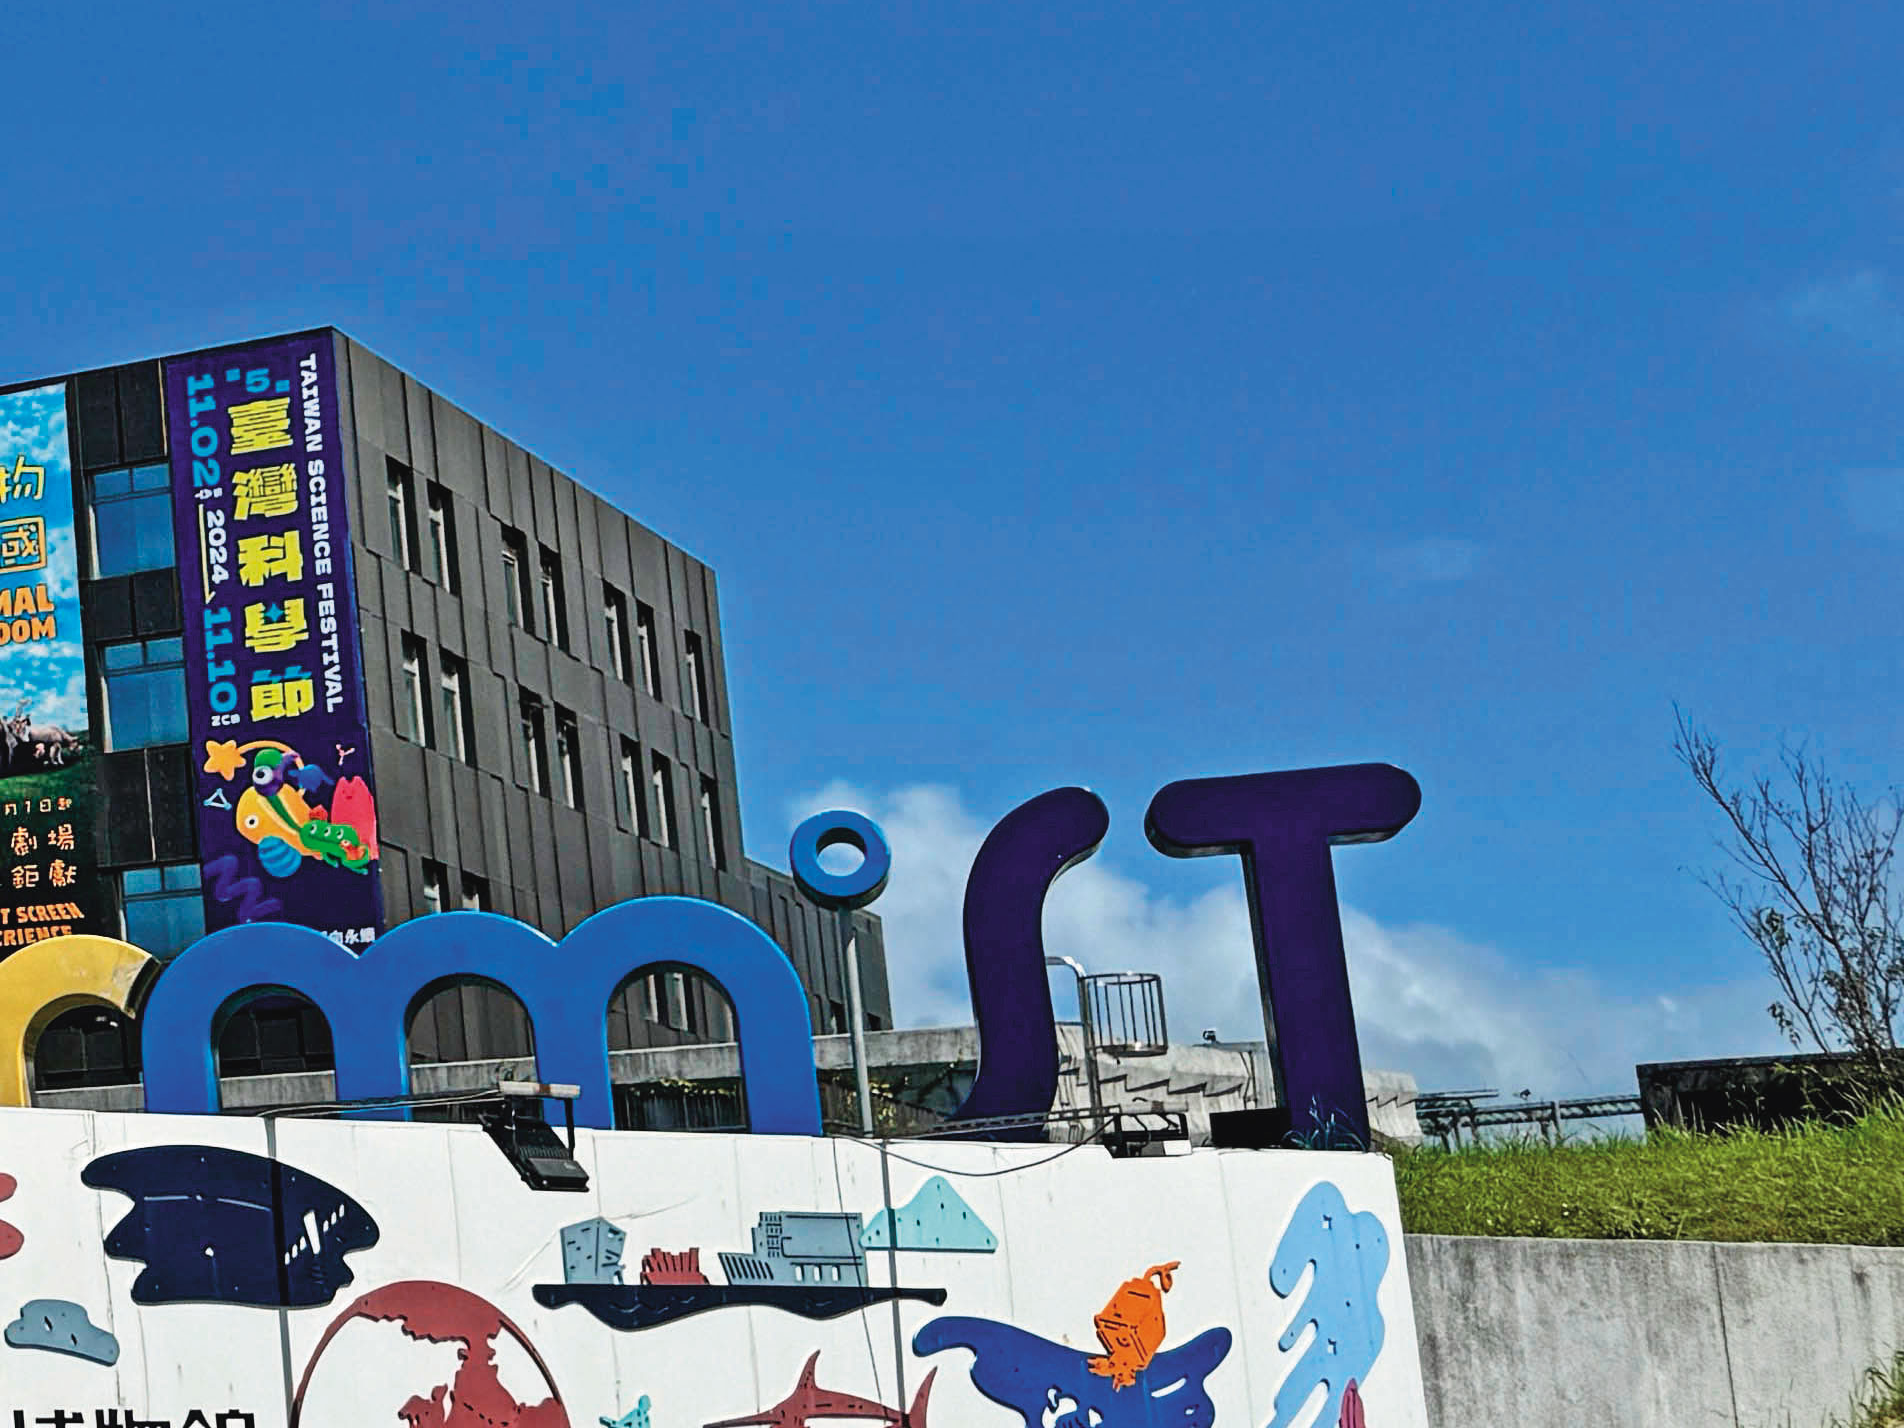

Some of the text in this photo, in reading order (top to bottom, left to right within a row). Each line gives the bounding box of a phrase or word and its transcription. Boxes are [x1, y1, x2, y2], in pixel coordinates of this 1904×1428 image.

[187, 373, 221, 487] 11.02
[206, 508, 229, 585] 2024
[228, 396, 315, 723] 臺灣科學節
[299, 353, 344, 713] TAIWAN SCIENCE FESTIVAL
[203, 606, 238, 713] 11.10
[15, 902, 85, 924] SCREEN
